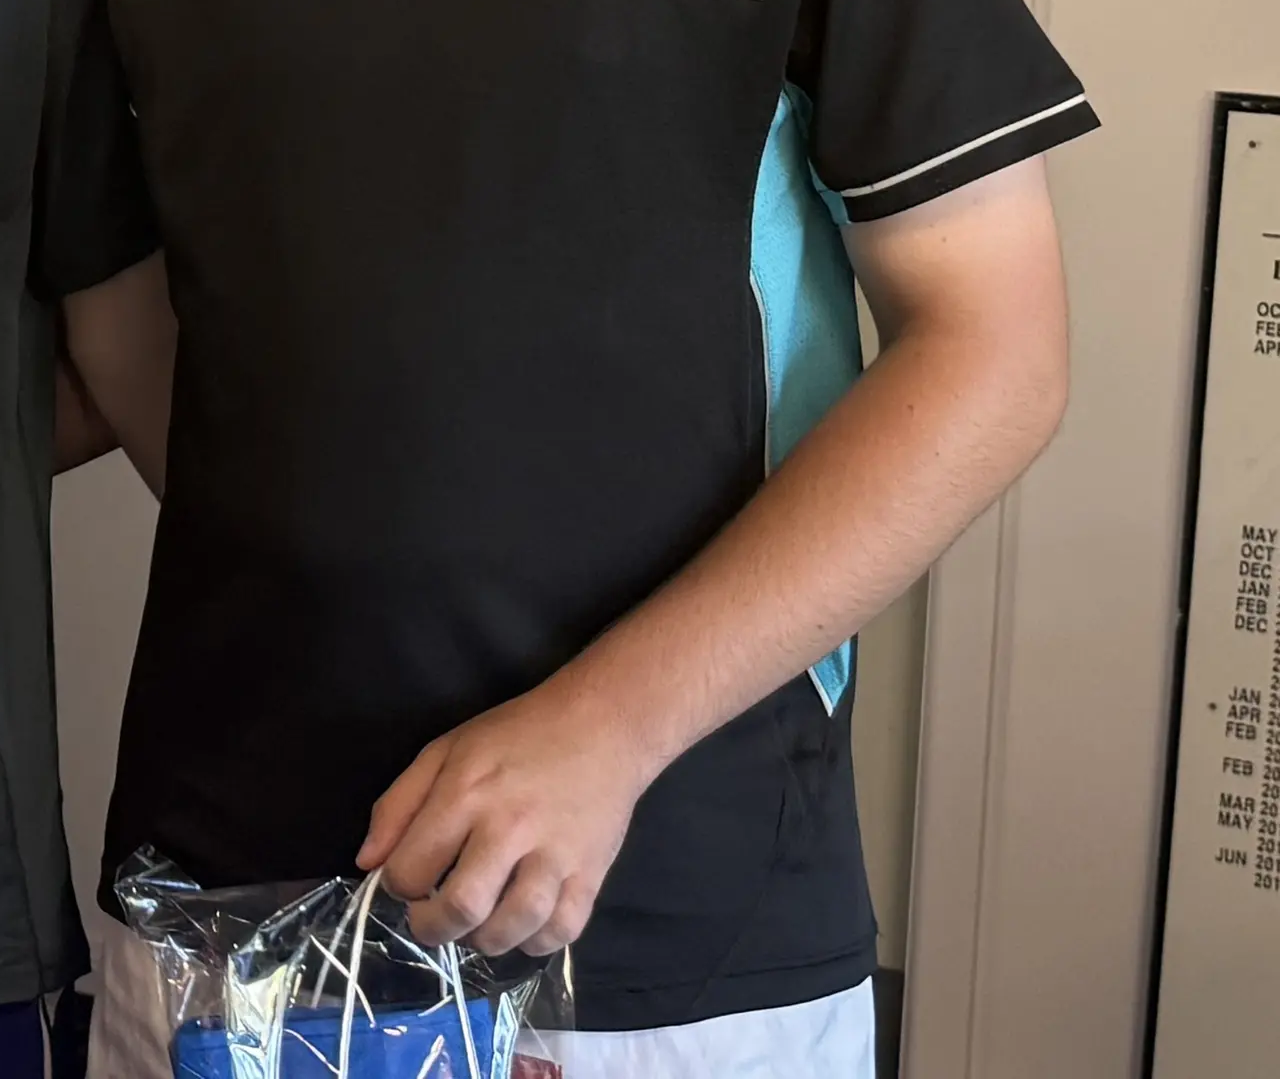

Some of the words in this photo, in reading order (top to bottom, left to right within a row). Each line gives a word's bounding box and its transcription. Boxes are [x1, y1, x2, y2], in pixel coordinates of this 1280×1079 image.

[1242, 525, 1277, 542] MAY
[1241, 542, 1275, 561] OCT
[1239, 560, 1272, 580] DEC
[1238, 579, 1270, 598] JAN
[1236, 596, 1267, 615] FEB
[1235, 614, 1268, 633] DEC
[1228, 686, 1261, 705] JAN
[1227, 704, 1261, 724] APR
[1225, 720, 1256, 740] FEB
[1223, 757, 1253, 775] FEB
[1220, 792, 1255, 813] MAR
[1218, 810, 1253, 831] MAY
[1216, 847, 1247, 866] JUN
